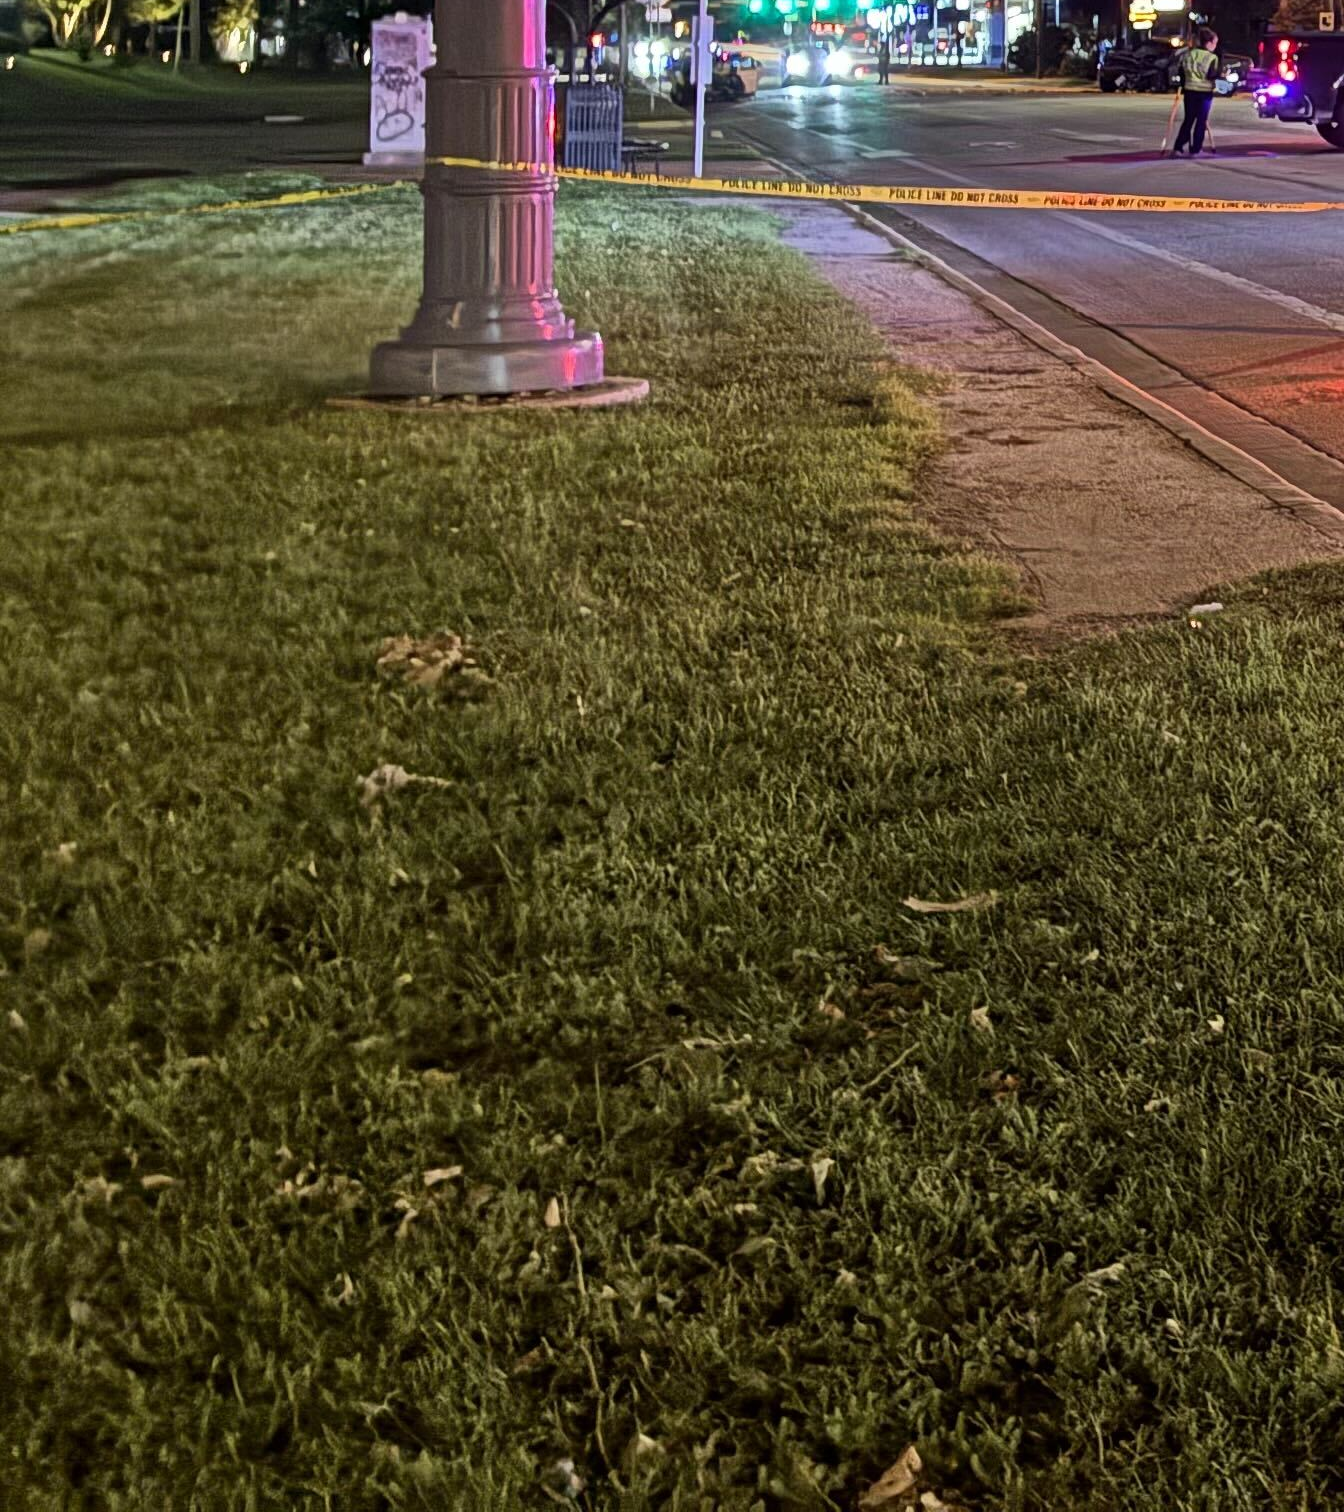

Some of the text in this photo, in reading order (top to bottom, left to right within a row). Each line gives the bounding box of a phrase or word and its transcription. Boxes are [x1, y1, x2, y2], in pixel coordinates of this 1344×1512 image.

[829, 184, 862, 197] CROSS
[888, 188, 1019, 204] POLICE LINE DO NOT CROSS
[1116, 198, 1135, 207] NOT
[1137, 198, 1167, 208] CROSS
